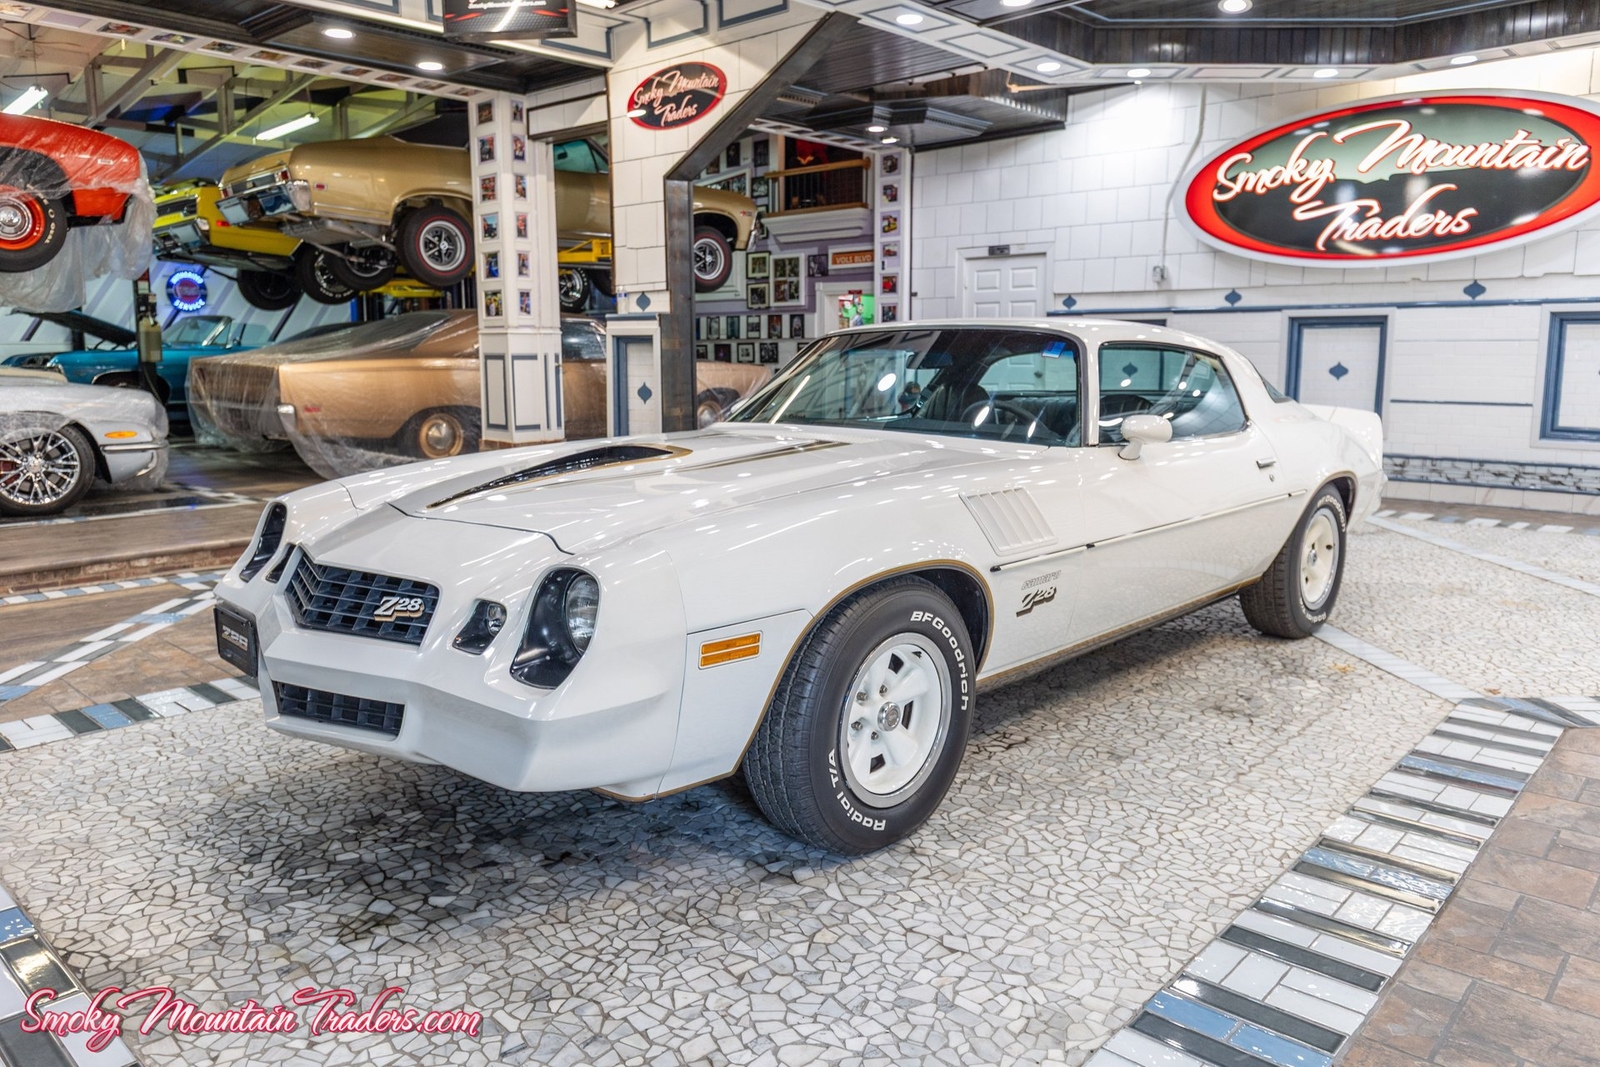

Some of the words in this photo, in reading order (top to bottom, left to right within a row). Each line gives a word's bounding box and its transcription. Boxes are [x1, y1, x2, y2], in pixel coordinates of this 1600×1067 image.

[633, 77, 664, 109] Smoky
[661, 70, 720, 93] Mountain
[654, 95, 698, 127] Traders
[1212, 131, 1337, 203] Smoky
[1332, 118, 1593, 176] Mountain
[1292, 183, 1481, 252] Traders
[835, 256, 853, 264] VOLS
[854, 254, 872, 263] BLVD
[373, 596, 425, 622] Z28
[1016, 586, 1057, 617] Z28
[910, 610, 970, 711] BFGoodrich
[828, 748, 838, 788] T/A
[836, 791, 887, 831] Radial
